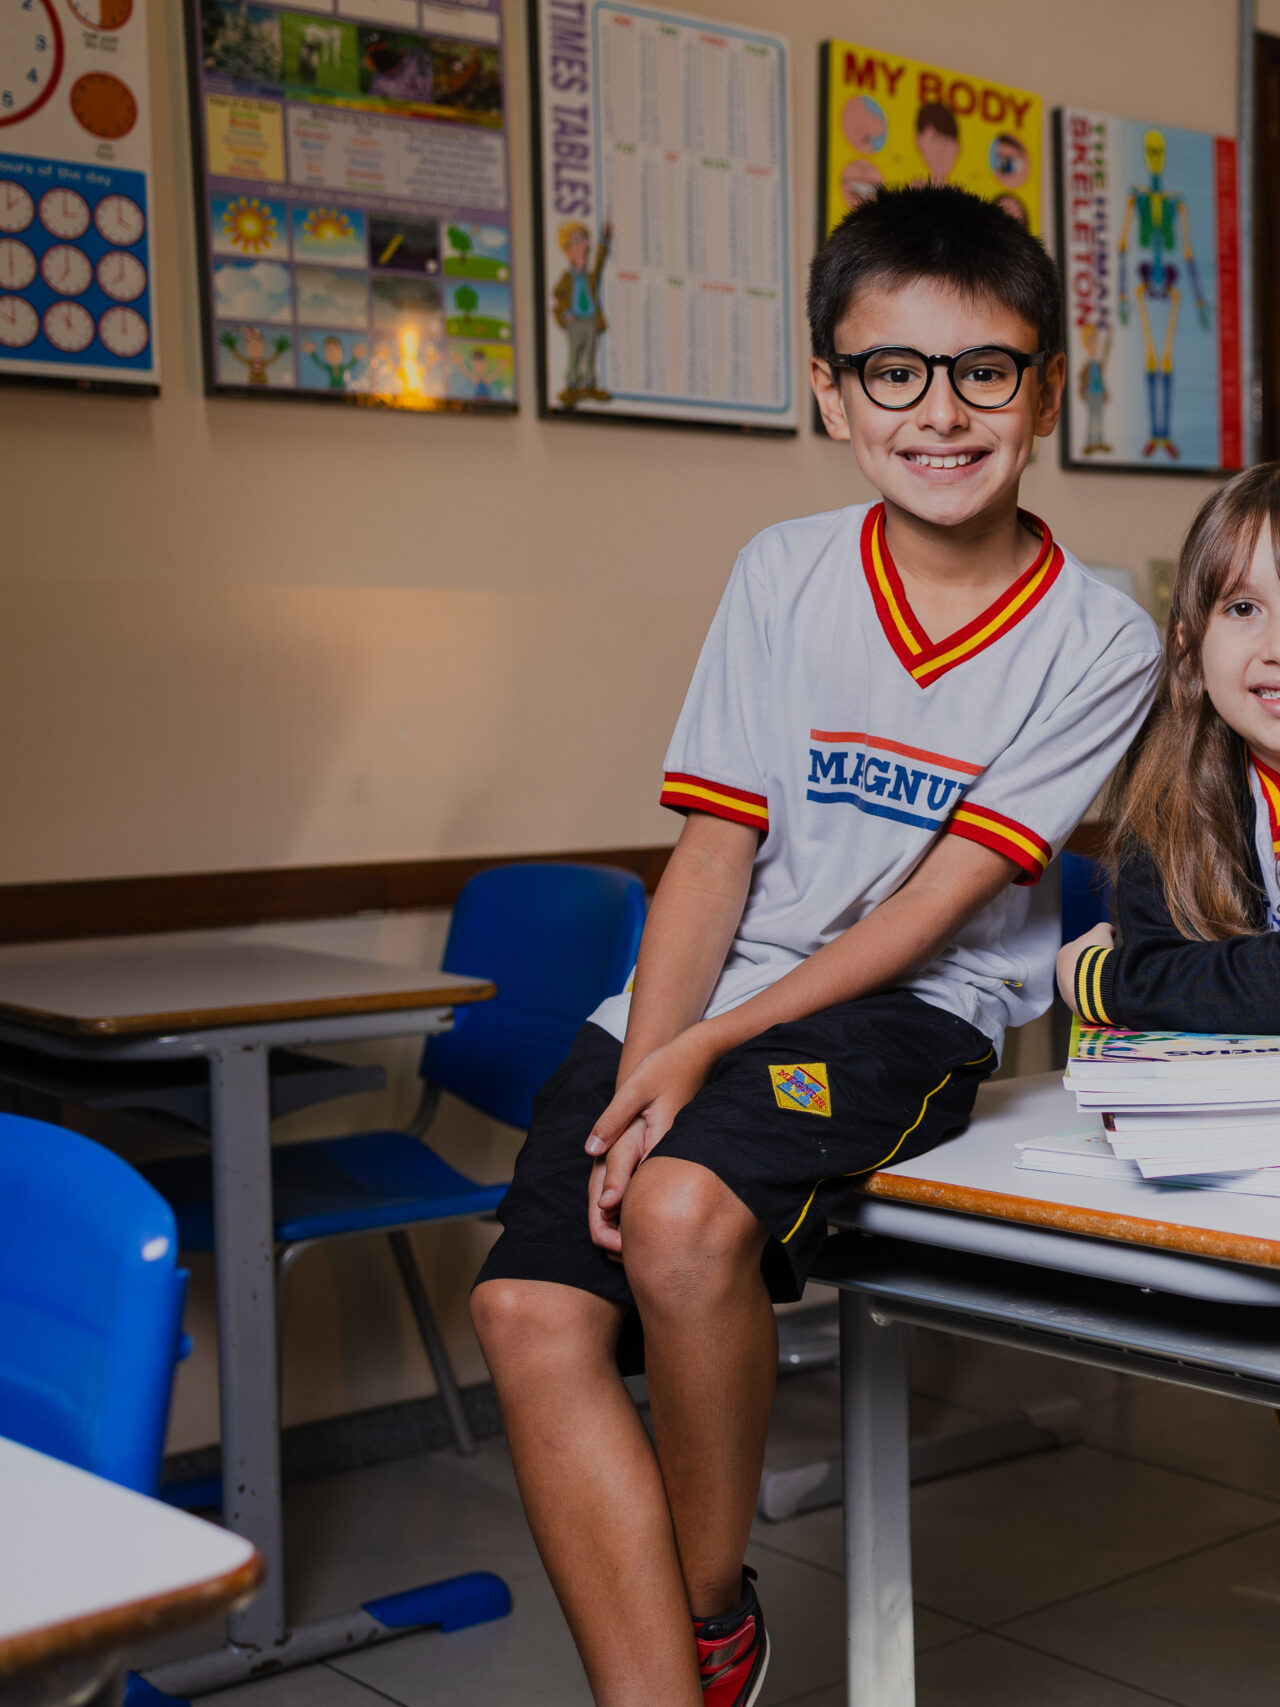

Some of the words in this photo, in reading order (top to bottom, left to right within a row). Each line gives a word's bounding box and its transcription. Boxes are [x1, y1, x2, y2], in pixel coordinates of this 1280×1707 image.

[26, 67, 38, 83] 4
[551, 0, 588, 94] TIMES
[844, 53, 905, 97] MY
[918, 71, 1032, 128] BODY
[0, 160, 34, 176] ours
[553, 106, 590, 217] TABLES
[1071, 118, 1093, 327] SKELETON
[807, 748, 972, 811] MAGNU
